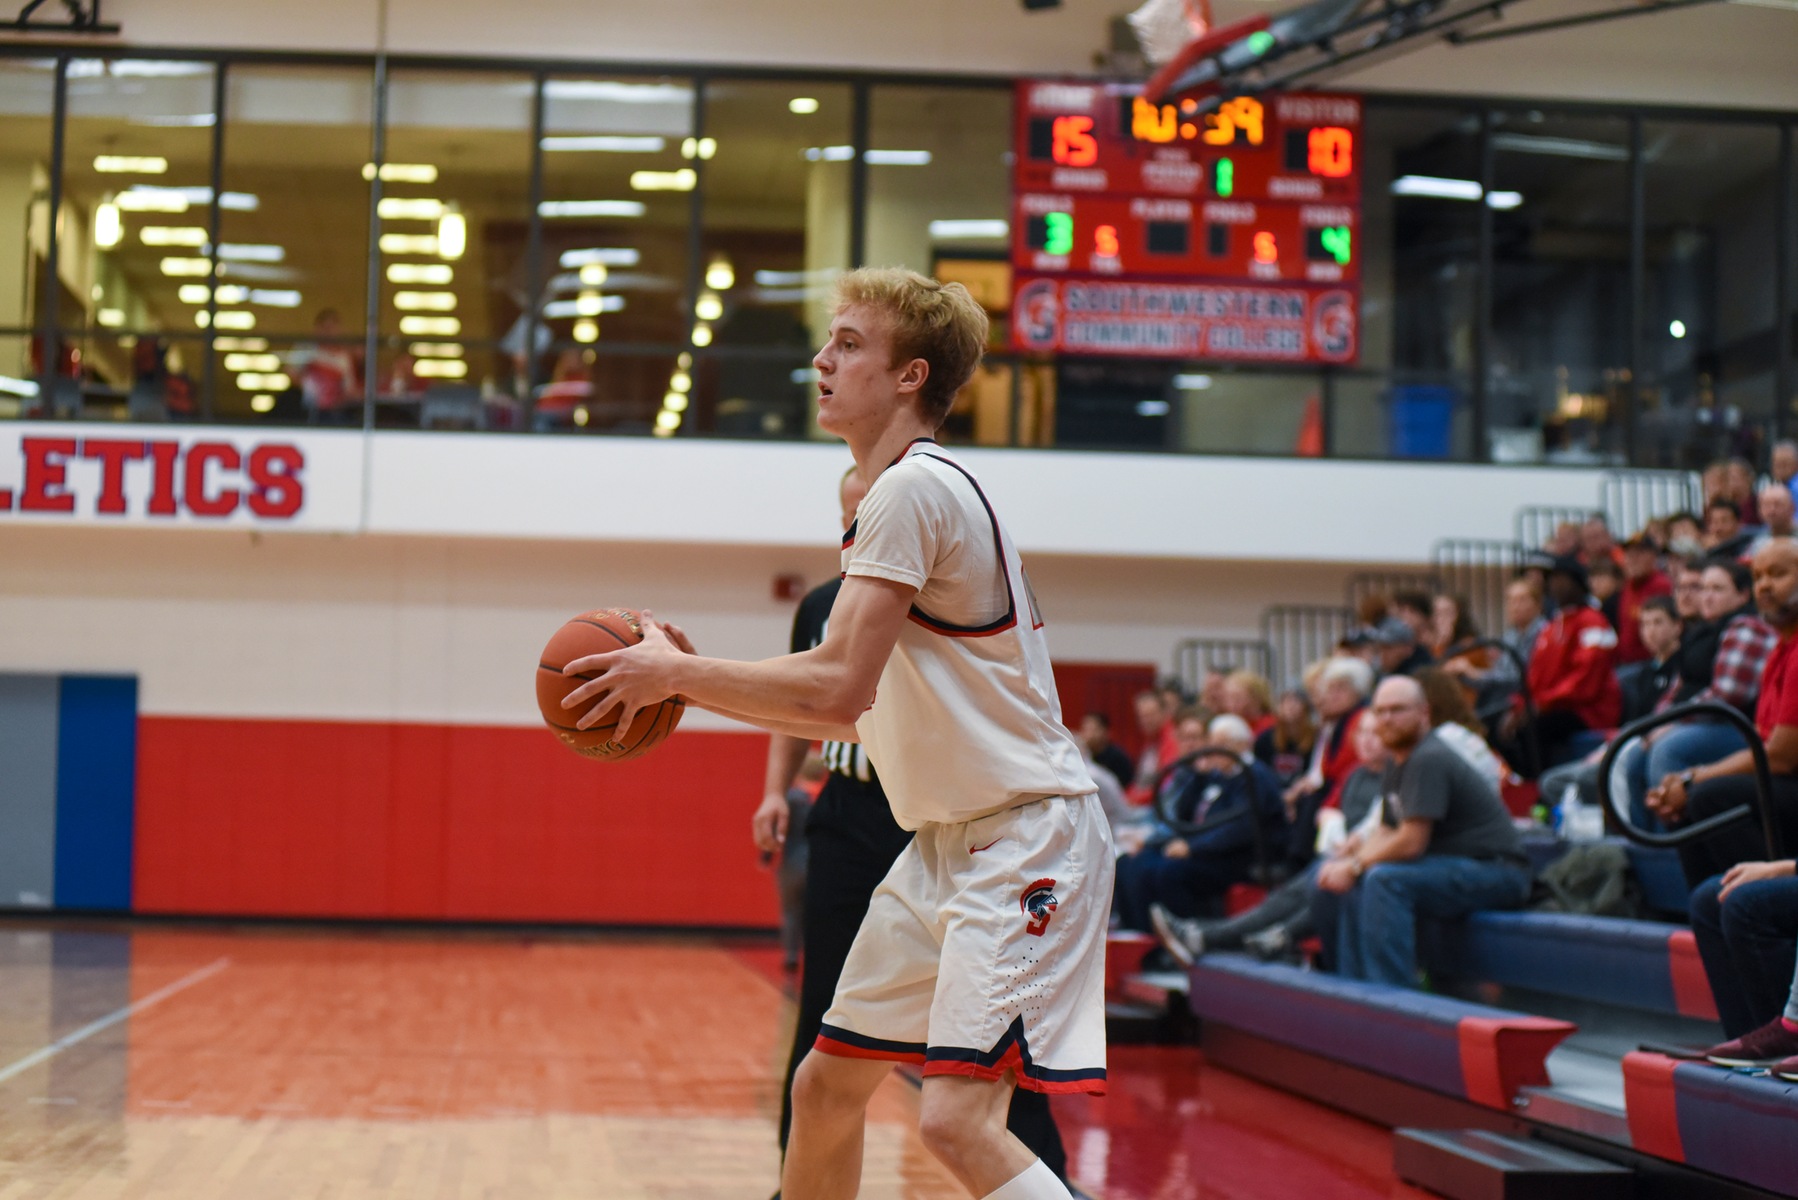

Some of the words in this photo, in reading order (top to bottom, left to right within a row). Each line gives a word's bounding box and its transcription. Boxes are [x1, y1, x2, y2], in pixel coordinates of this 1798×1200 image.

[1052, 115, 1098, 167] 15
[1307, 126, 1353, 177] 10
[1215, 157, 1234, 197] 1
[1044, 212, 1073, 256] 3
[1321, 225, 1351, 265] 4
[1065, 285, 1305, 317] SOUTHWESTERN
[1065, 321, 1201, 351] COMMUNITY
[1209, 326, 1305, 354] COLLEGE
[0, 435, 305, 518] ETICS
